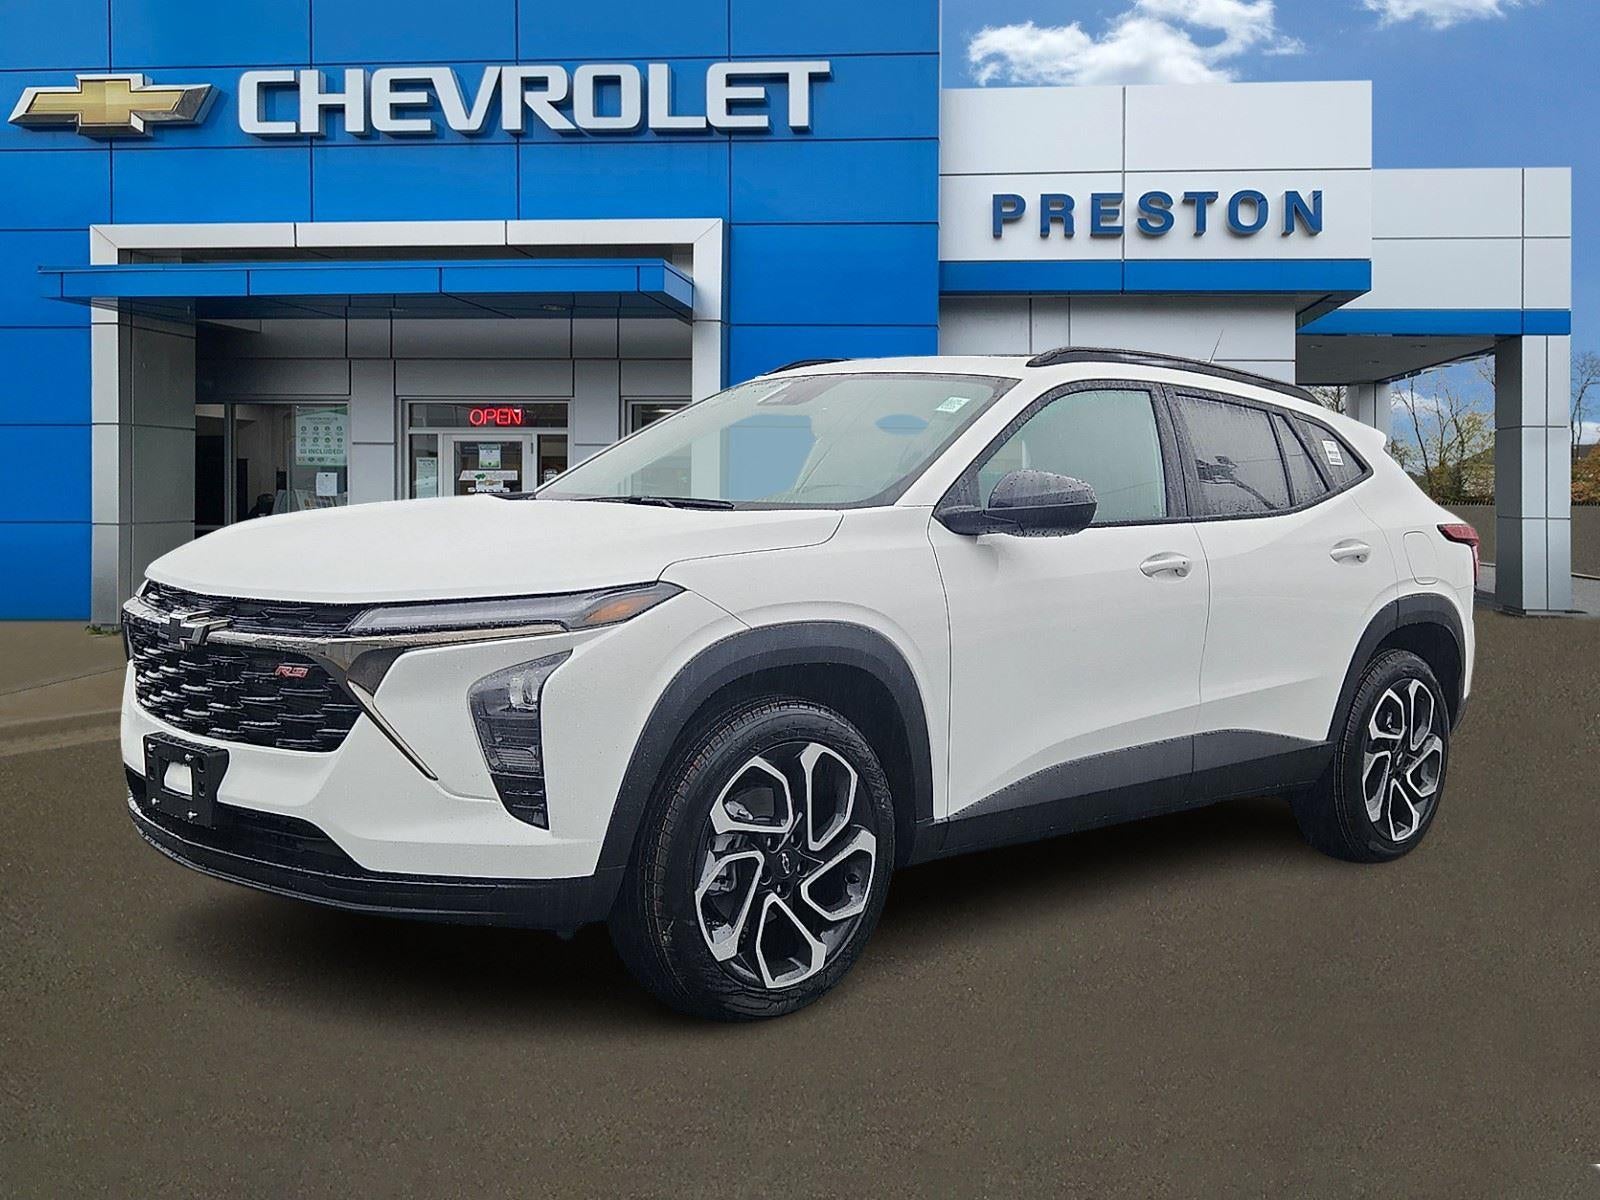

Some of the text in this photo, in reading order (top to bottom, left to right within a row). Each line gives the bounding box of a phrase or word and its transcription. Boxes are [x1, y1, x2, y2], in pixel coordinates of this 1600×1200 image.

[238, 62, 830, 135] CHEVROLET
[992, 190, 1323, 239] PRESTON
[469, 408, 522, 425] OPEN
[274, 665, 309, 678] RS
